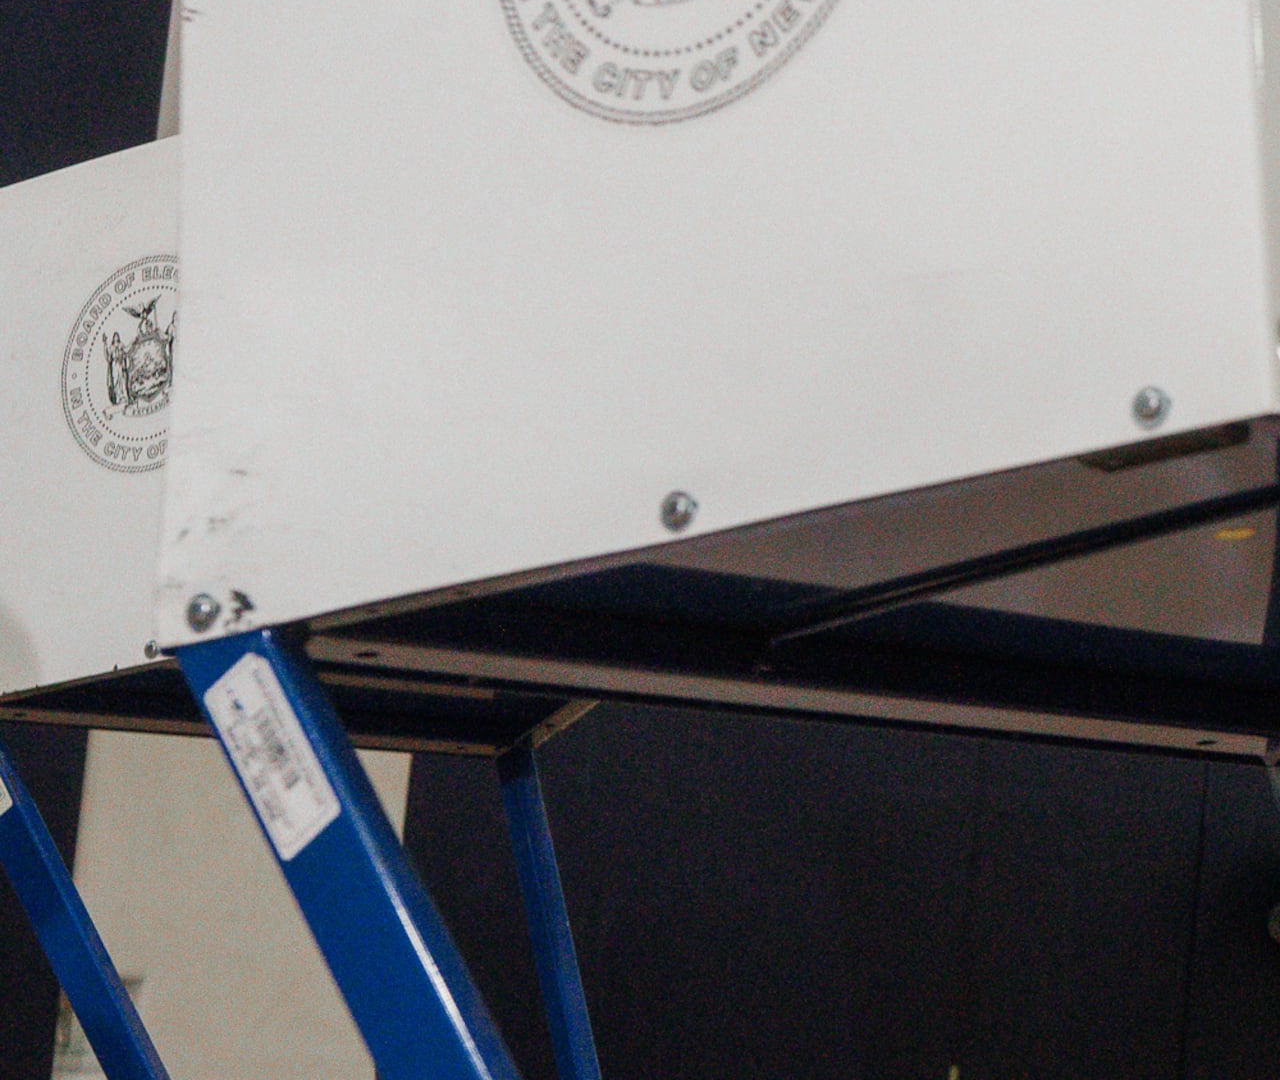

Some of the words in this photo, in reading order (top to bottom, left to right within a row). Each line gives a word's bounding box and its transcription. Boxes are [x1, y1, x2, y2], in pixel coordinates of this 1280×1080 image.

[530, 1, 591, 75] THE
[591, 60, 681, 101] CITY
[689, 46, 740, 93] OF
[71, 293, 112, 362] BOARD
[114, 271, 135, 295] OF
[70, 386, 84, 411] IN
[77, 410, 104, 447] THE
[103, 440, 143, 462] CITY
